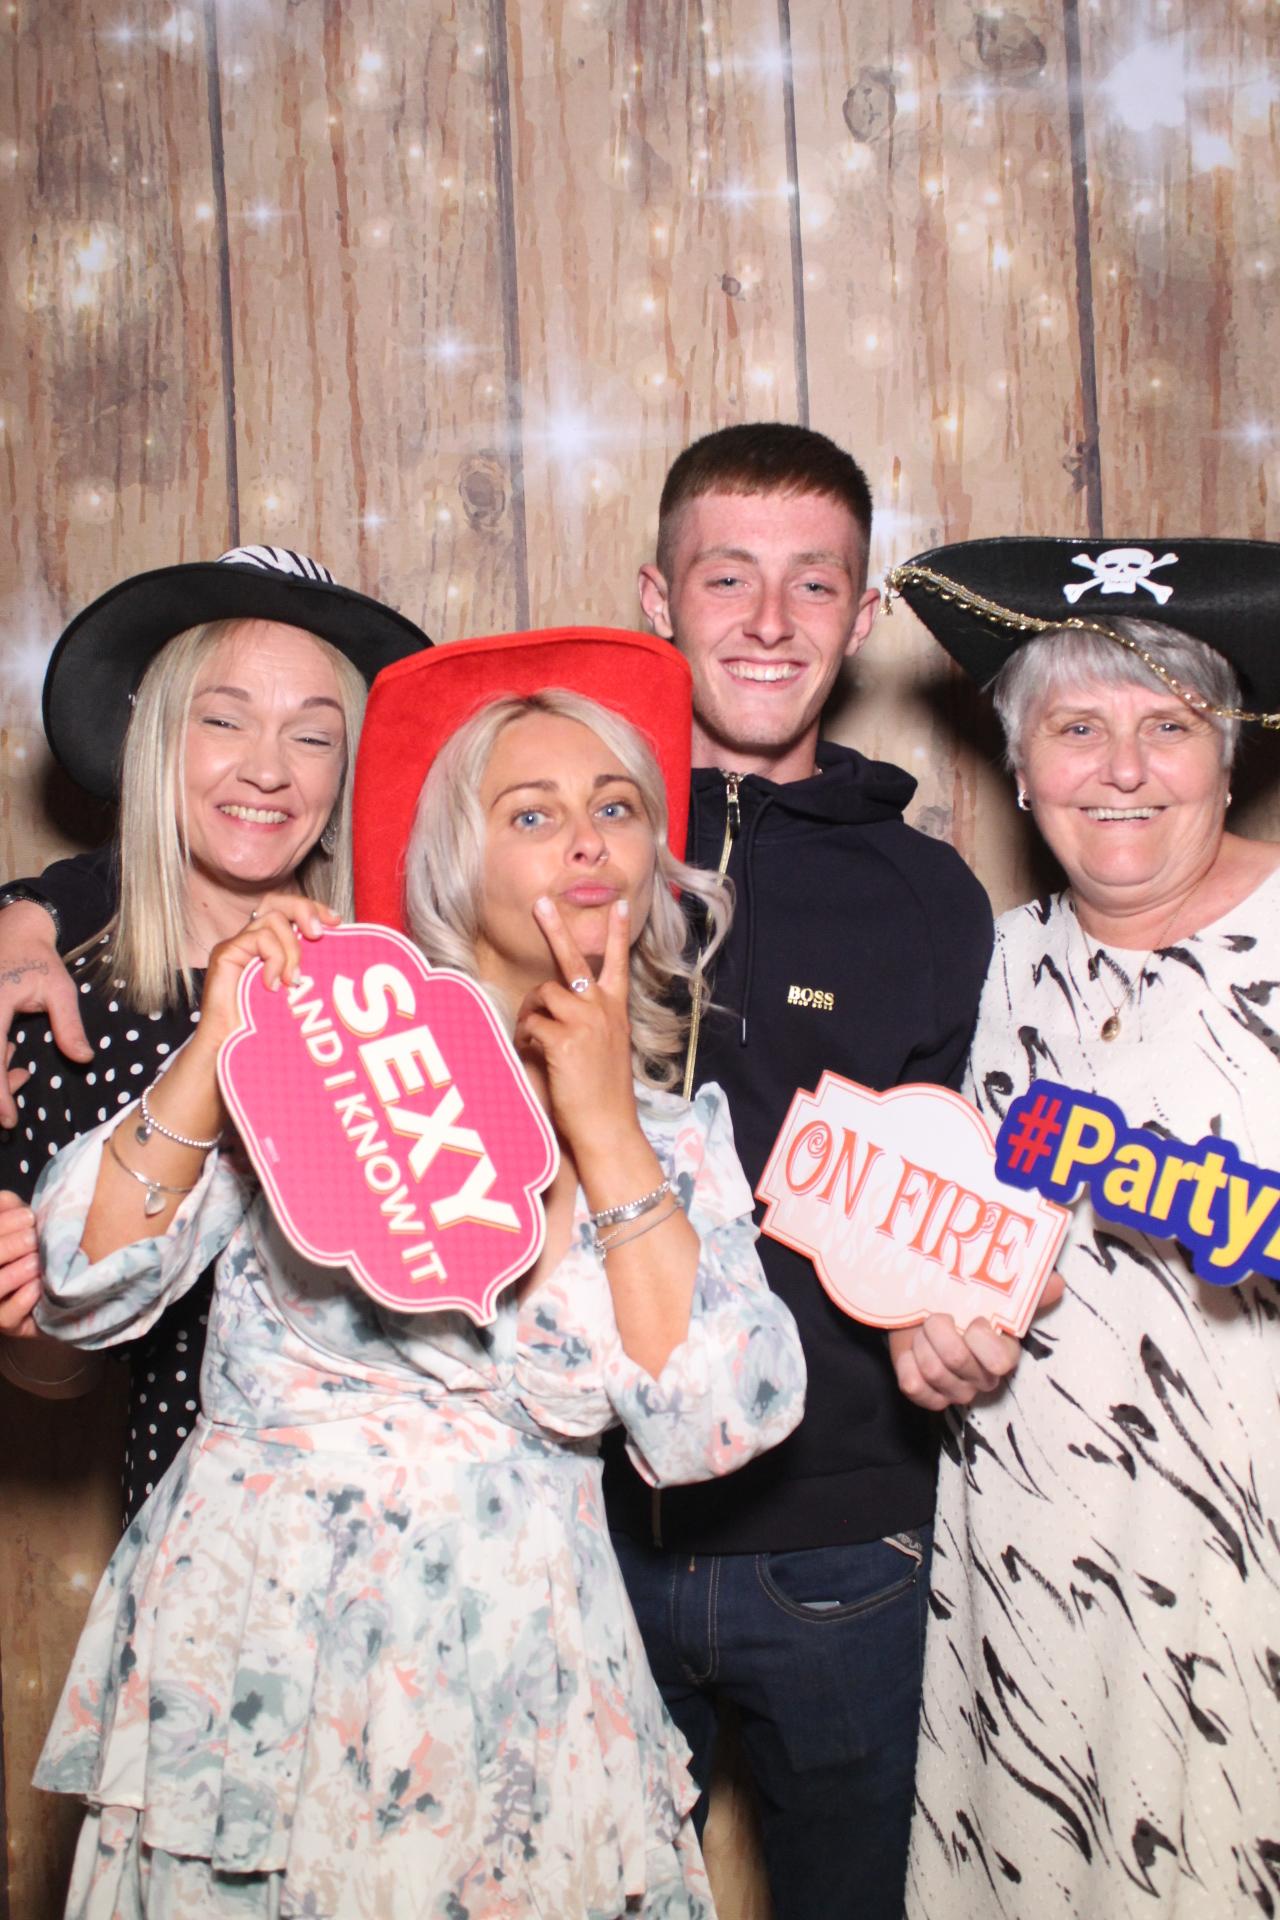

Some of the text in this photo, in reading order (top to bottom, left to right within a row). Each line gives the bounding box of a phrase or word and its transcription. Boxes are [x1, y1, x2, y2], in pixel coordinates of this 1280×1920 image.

[787, 985, 835, 1006] BOSS
[286, 975, 447, 1283] AND I KNOW IT
[333, 963, 522, 1234] SEXY
[1007, 1094, 1280, 1268] #Party
[784, 1120, 1038, 1297] ON FIRE
